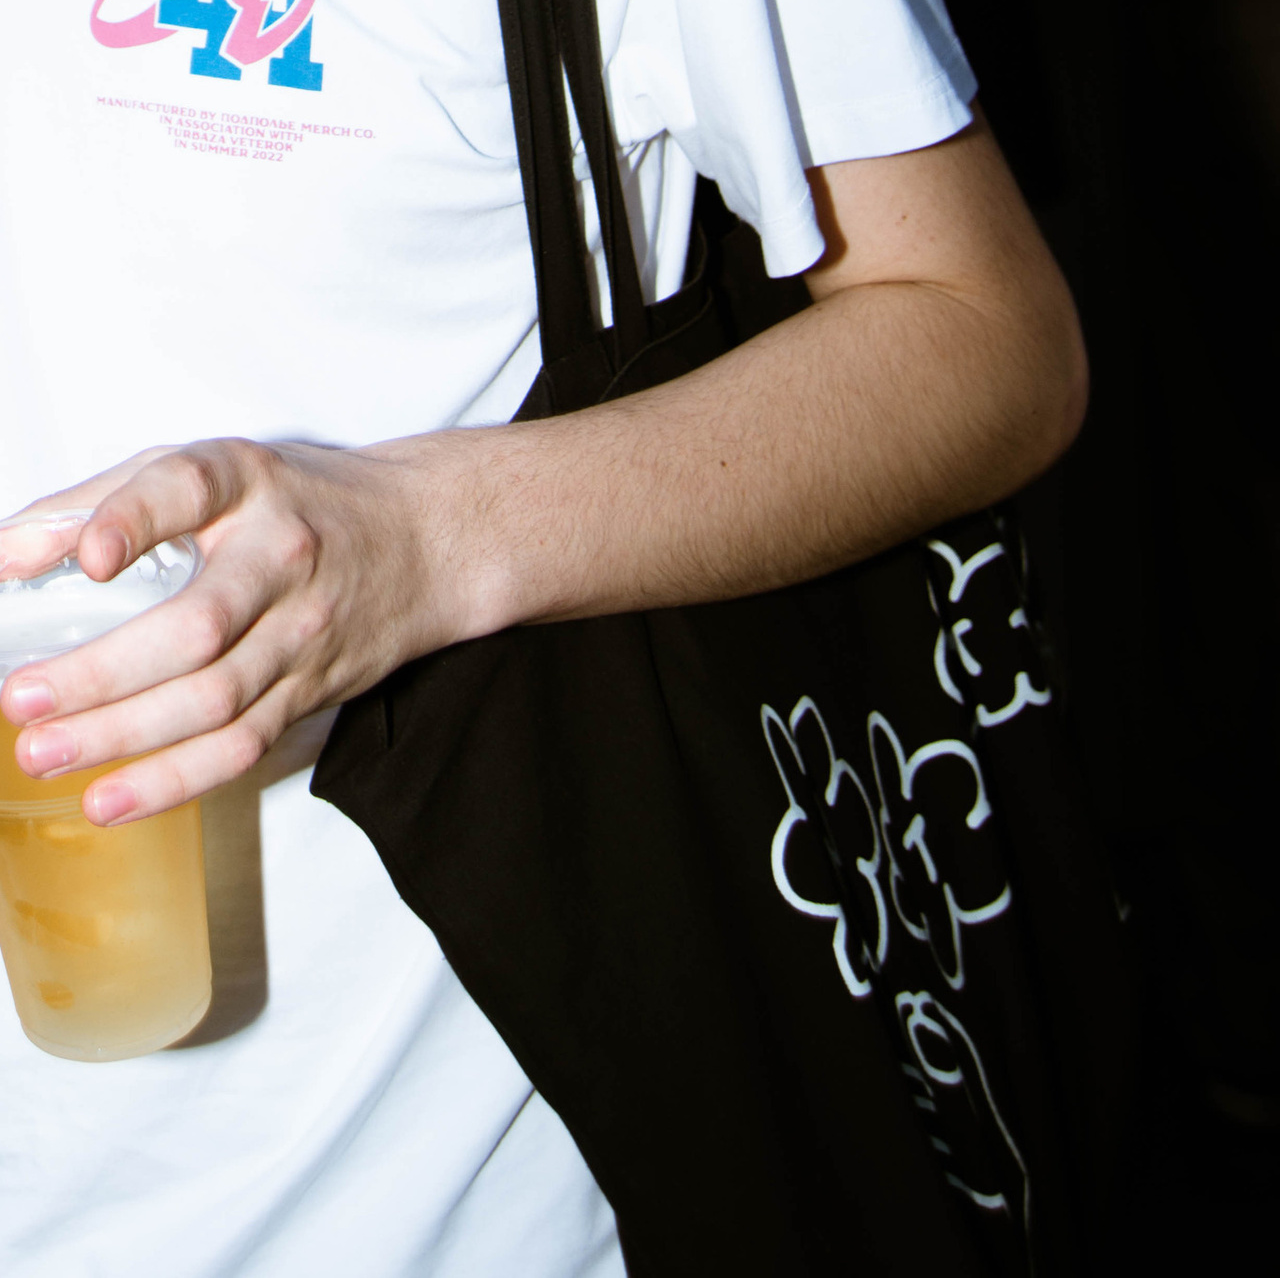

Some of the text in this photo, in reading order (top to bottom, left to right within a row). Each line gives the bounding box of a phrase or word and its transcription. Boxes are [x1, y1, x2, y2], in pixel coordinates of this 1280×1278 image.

[97, 96, 196, 118] MANUFACTURED
[200, 110, 216, 121] BY
[301, 123, 351, 137] MERCH
[354, 128, 376, 140] CO.
[159, 115, 303, 143] IN ASSOCIATION WITH
[168, 126, 293, 152] TURBAZA VETEROK
[175, 138, 283, 163] IN SUMMER 2022
